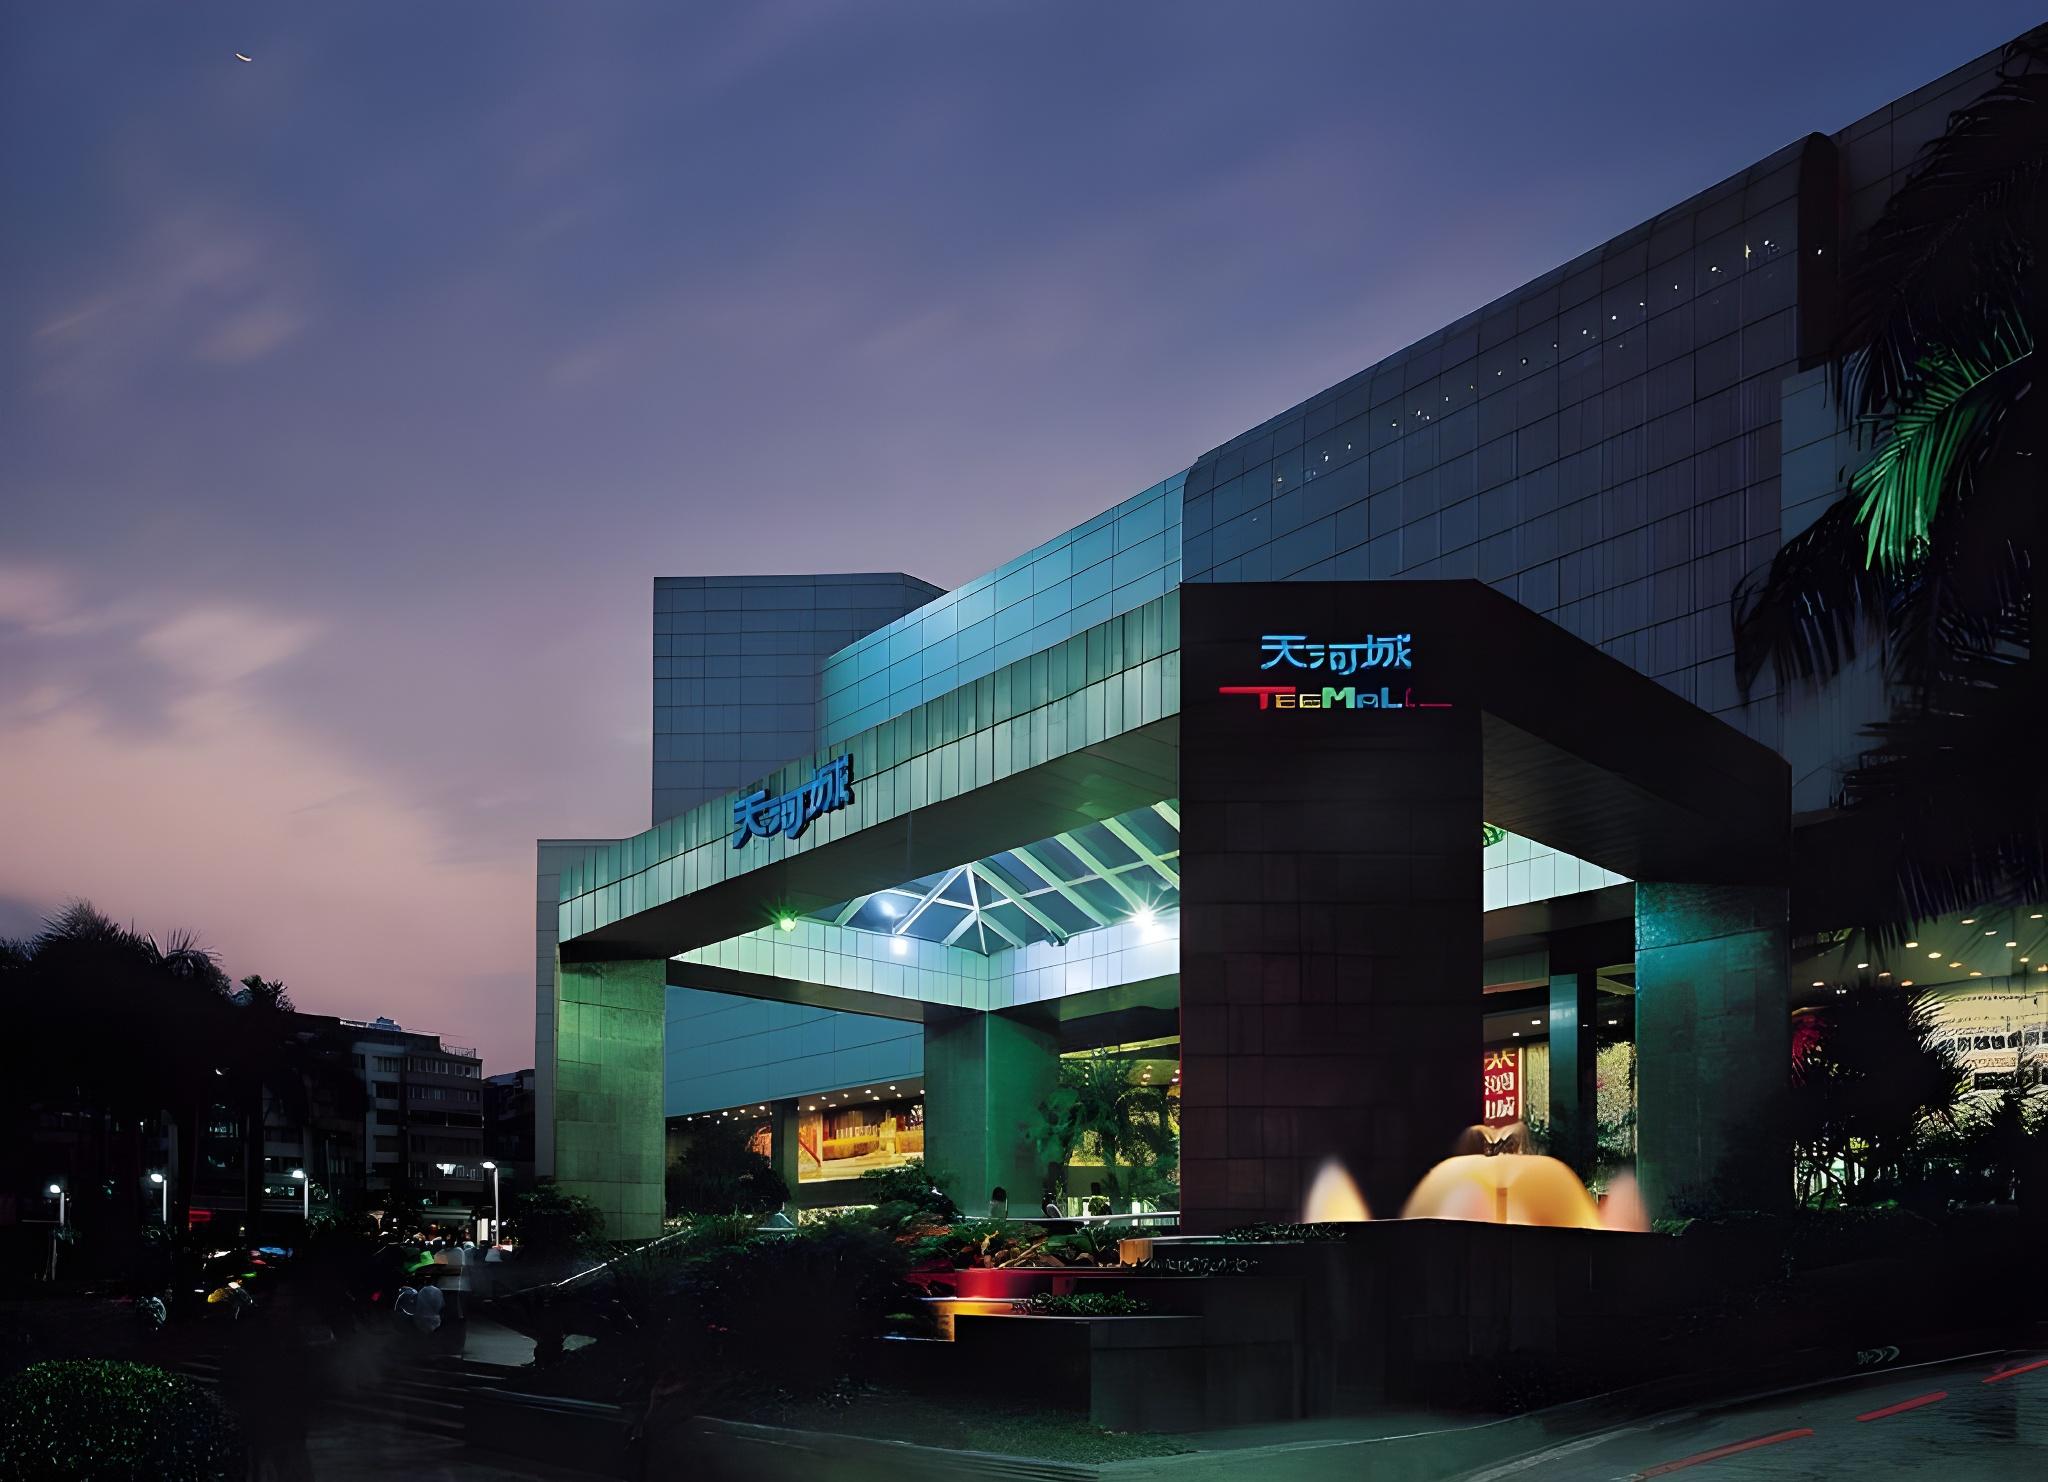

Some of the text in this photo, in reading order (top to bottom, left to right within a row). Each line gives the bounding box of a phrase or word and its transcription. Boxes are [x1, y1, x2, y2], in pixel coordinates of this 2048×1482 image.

[1260, 634, 1411, 675] 天河城
[732, 753, 855, 850] 天河城
